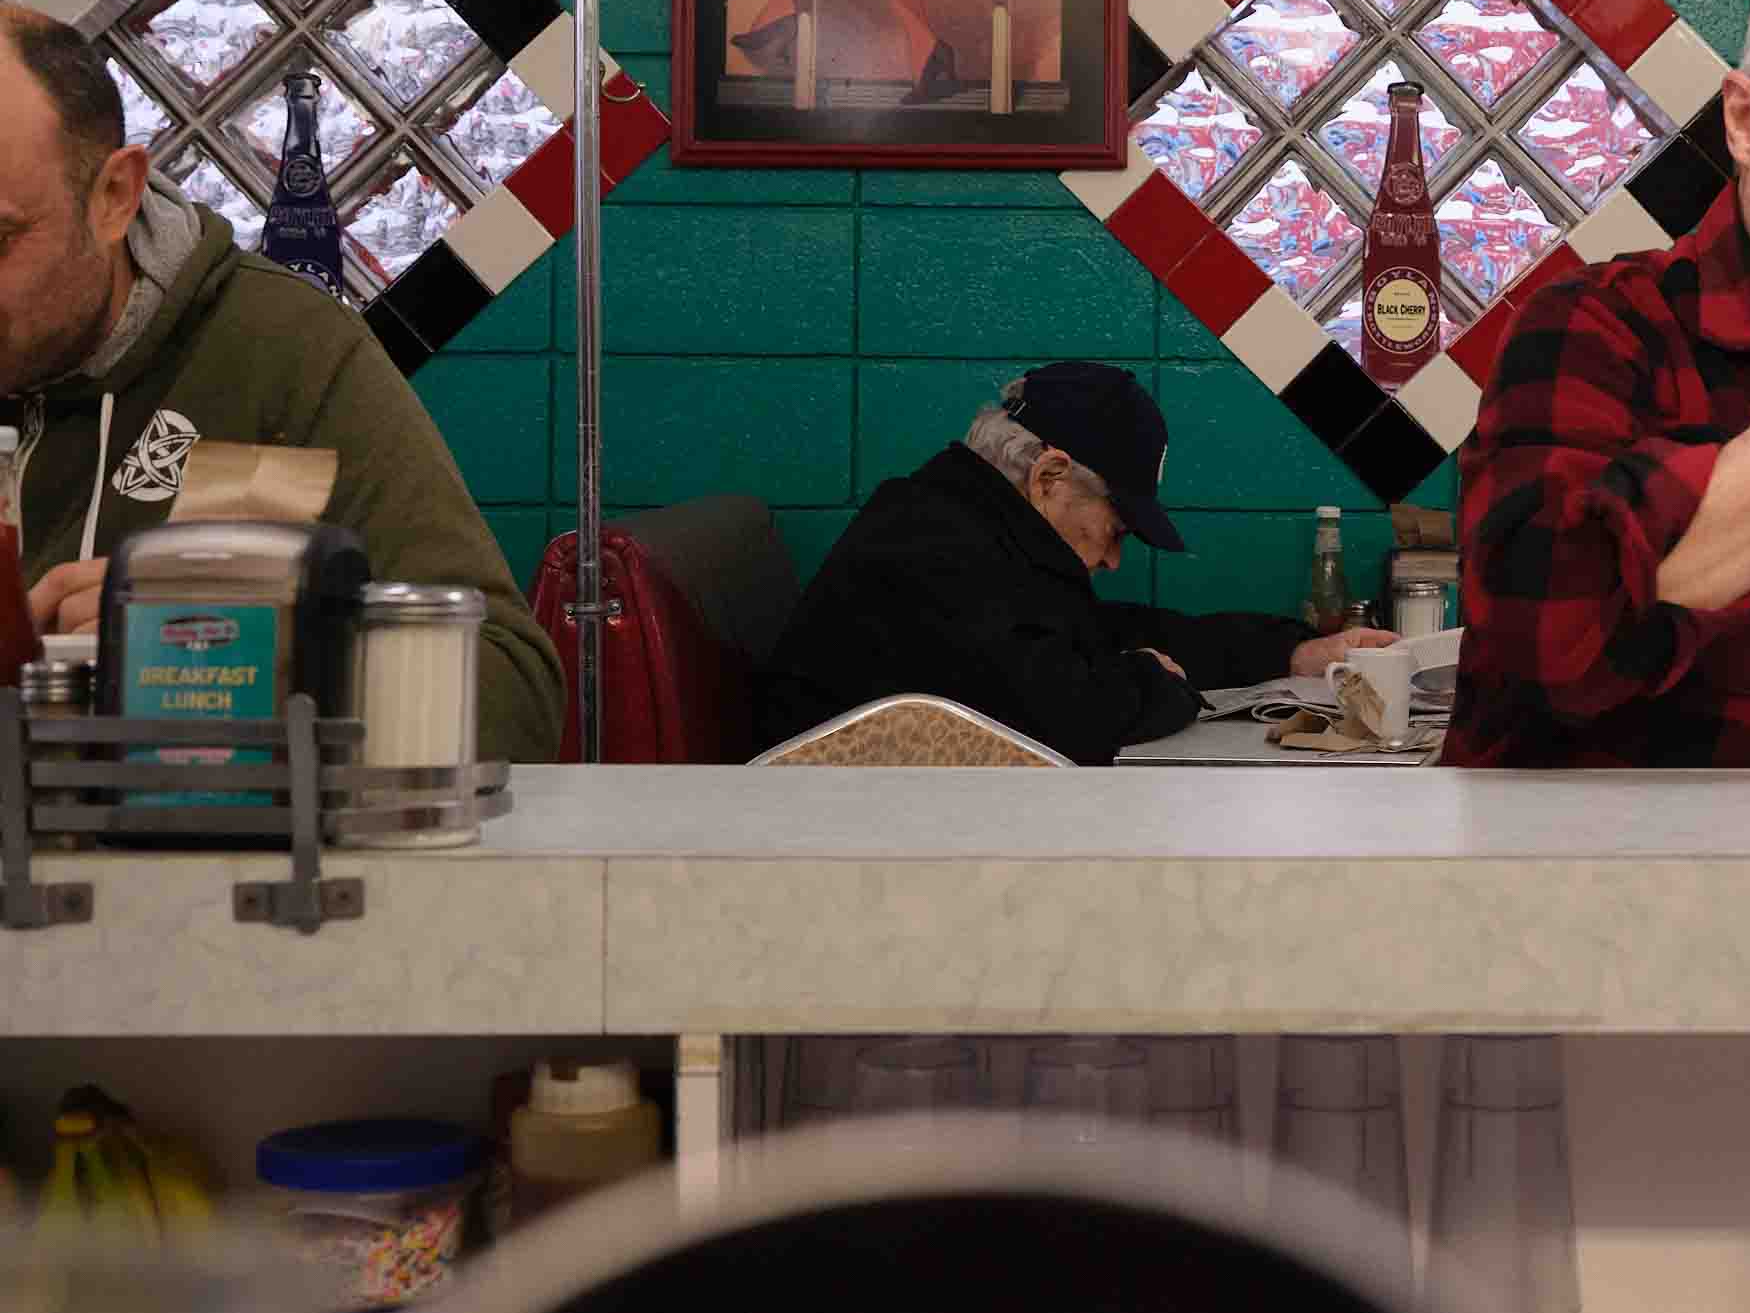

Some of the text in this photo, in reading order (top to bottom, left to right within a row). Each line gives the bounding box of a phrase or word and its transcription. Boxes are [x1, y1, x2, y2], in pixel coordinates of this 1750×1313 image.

[1376, 303, 1399, 316] BLACK
[138, 665, 258, 688] BREAKFAST
[161, 691, 234, 710] LUNCH
